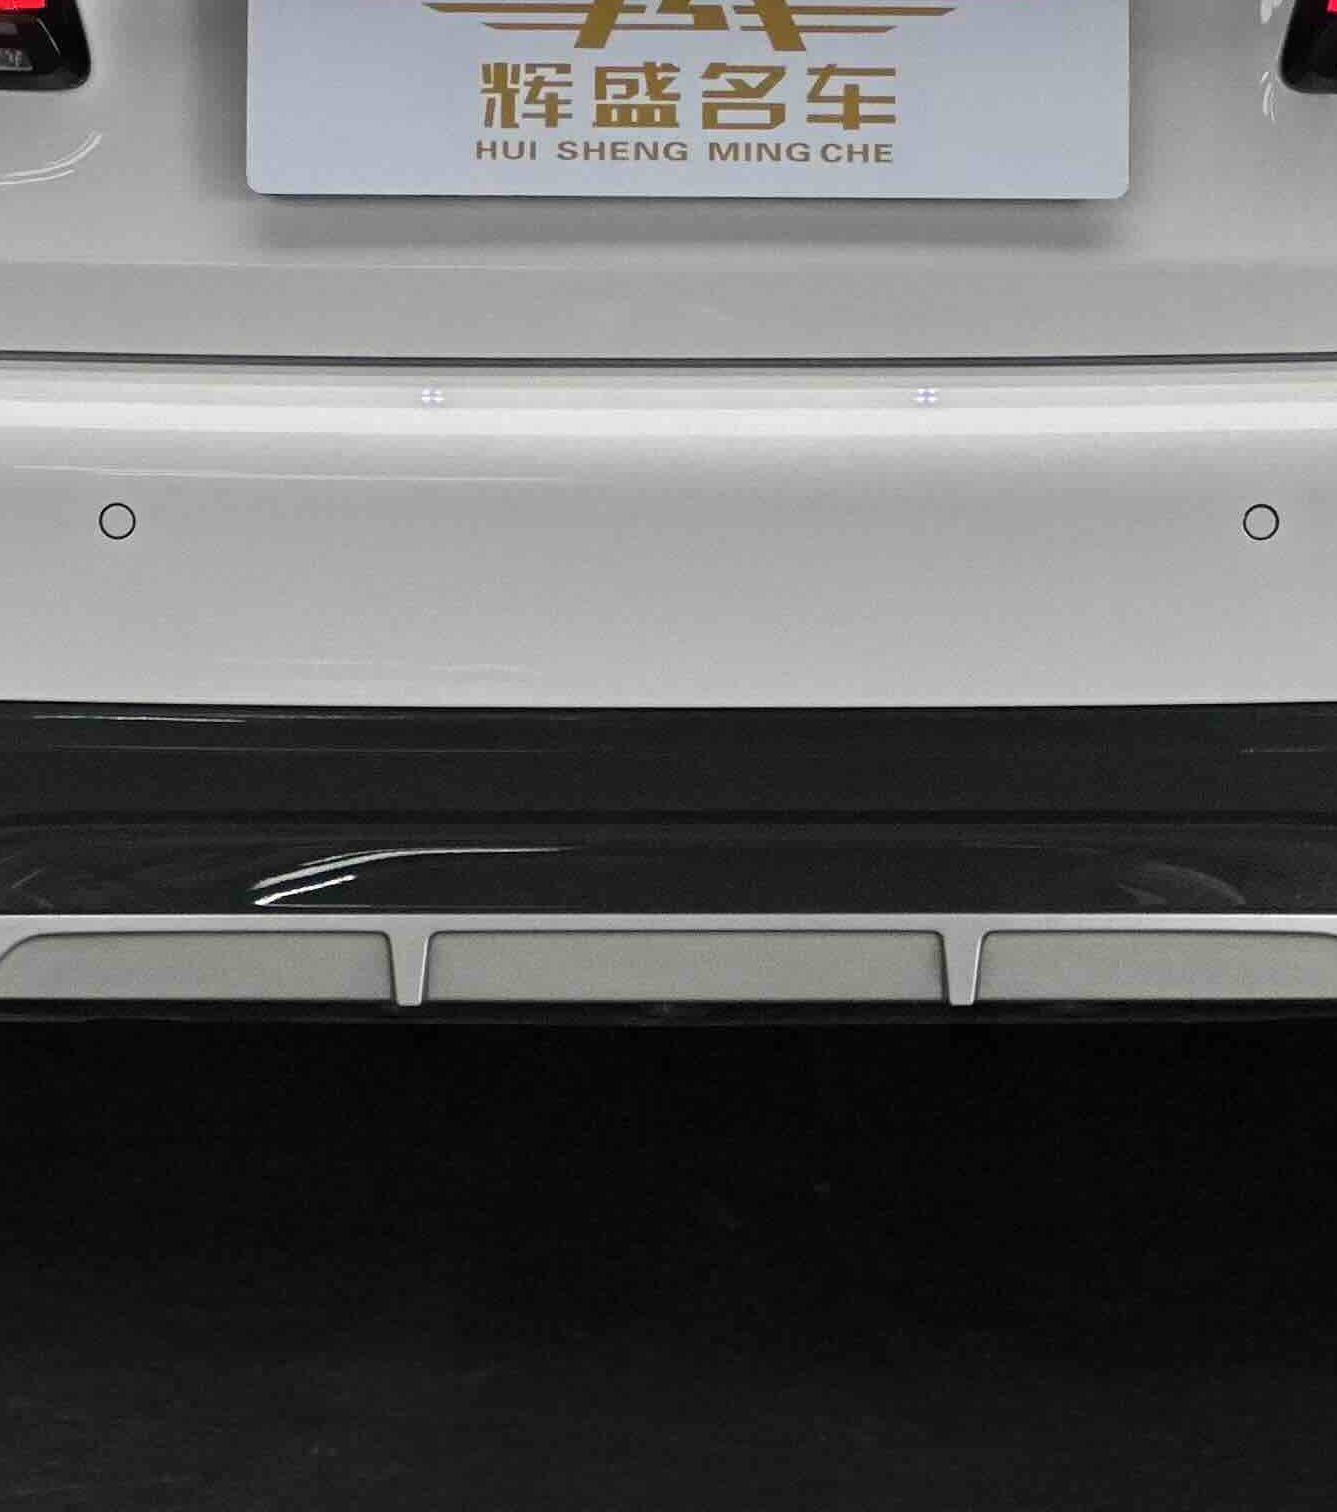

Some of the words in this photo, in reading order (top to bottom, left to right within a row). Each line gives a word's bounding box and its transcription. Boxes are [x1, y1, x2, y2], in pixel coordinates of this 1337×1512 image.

[481, 61, 897, 130] 辉盛名车
[475, 140, 538, 161] HUI
[557, 141, 689, 162] SHENG
[708, 142, 811, 163] MING
[820, 143, 893, 164] CHE
